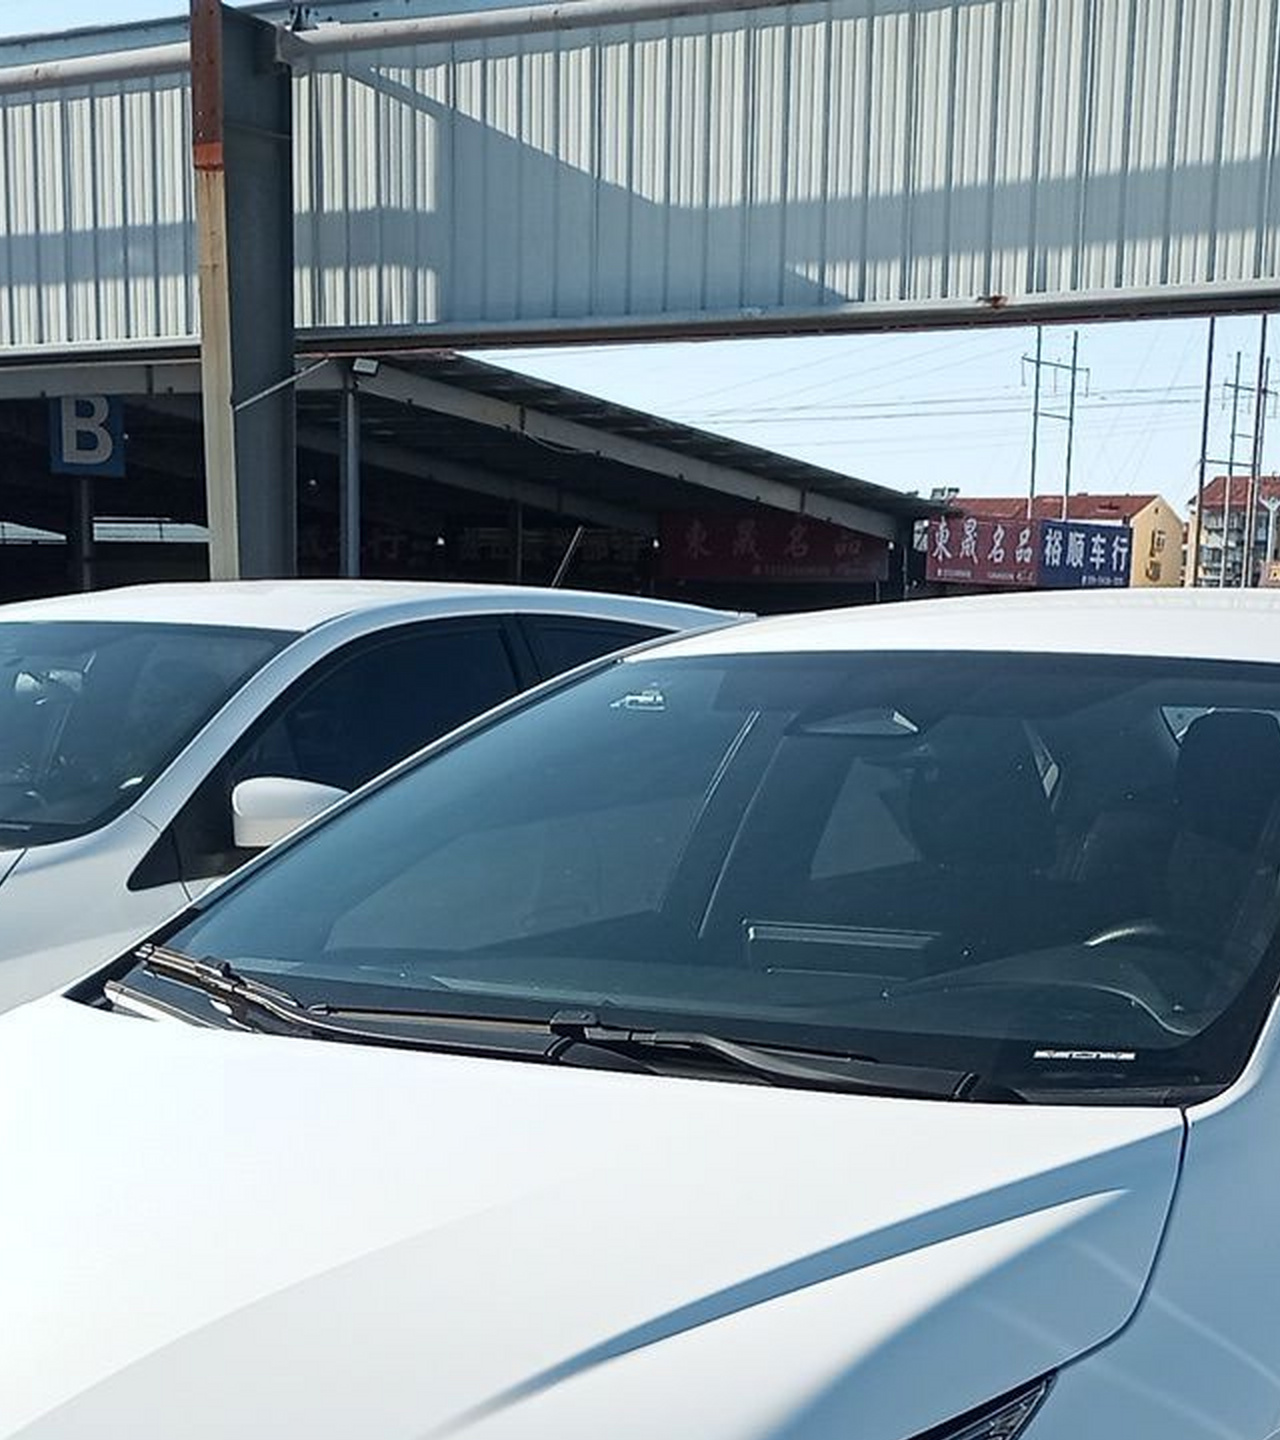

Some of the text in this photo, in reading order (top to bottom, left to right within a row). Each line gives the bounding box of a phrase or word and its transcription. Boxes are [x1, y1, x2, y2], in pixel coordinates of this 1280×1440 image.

[61, 394, 113, 464] B
[1044, 528, 1129, 572] 裕顺车行
